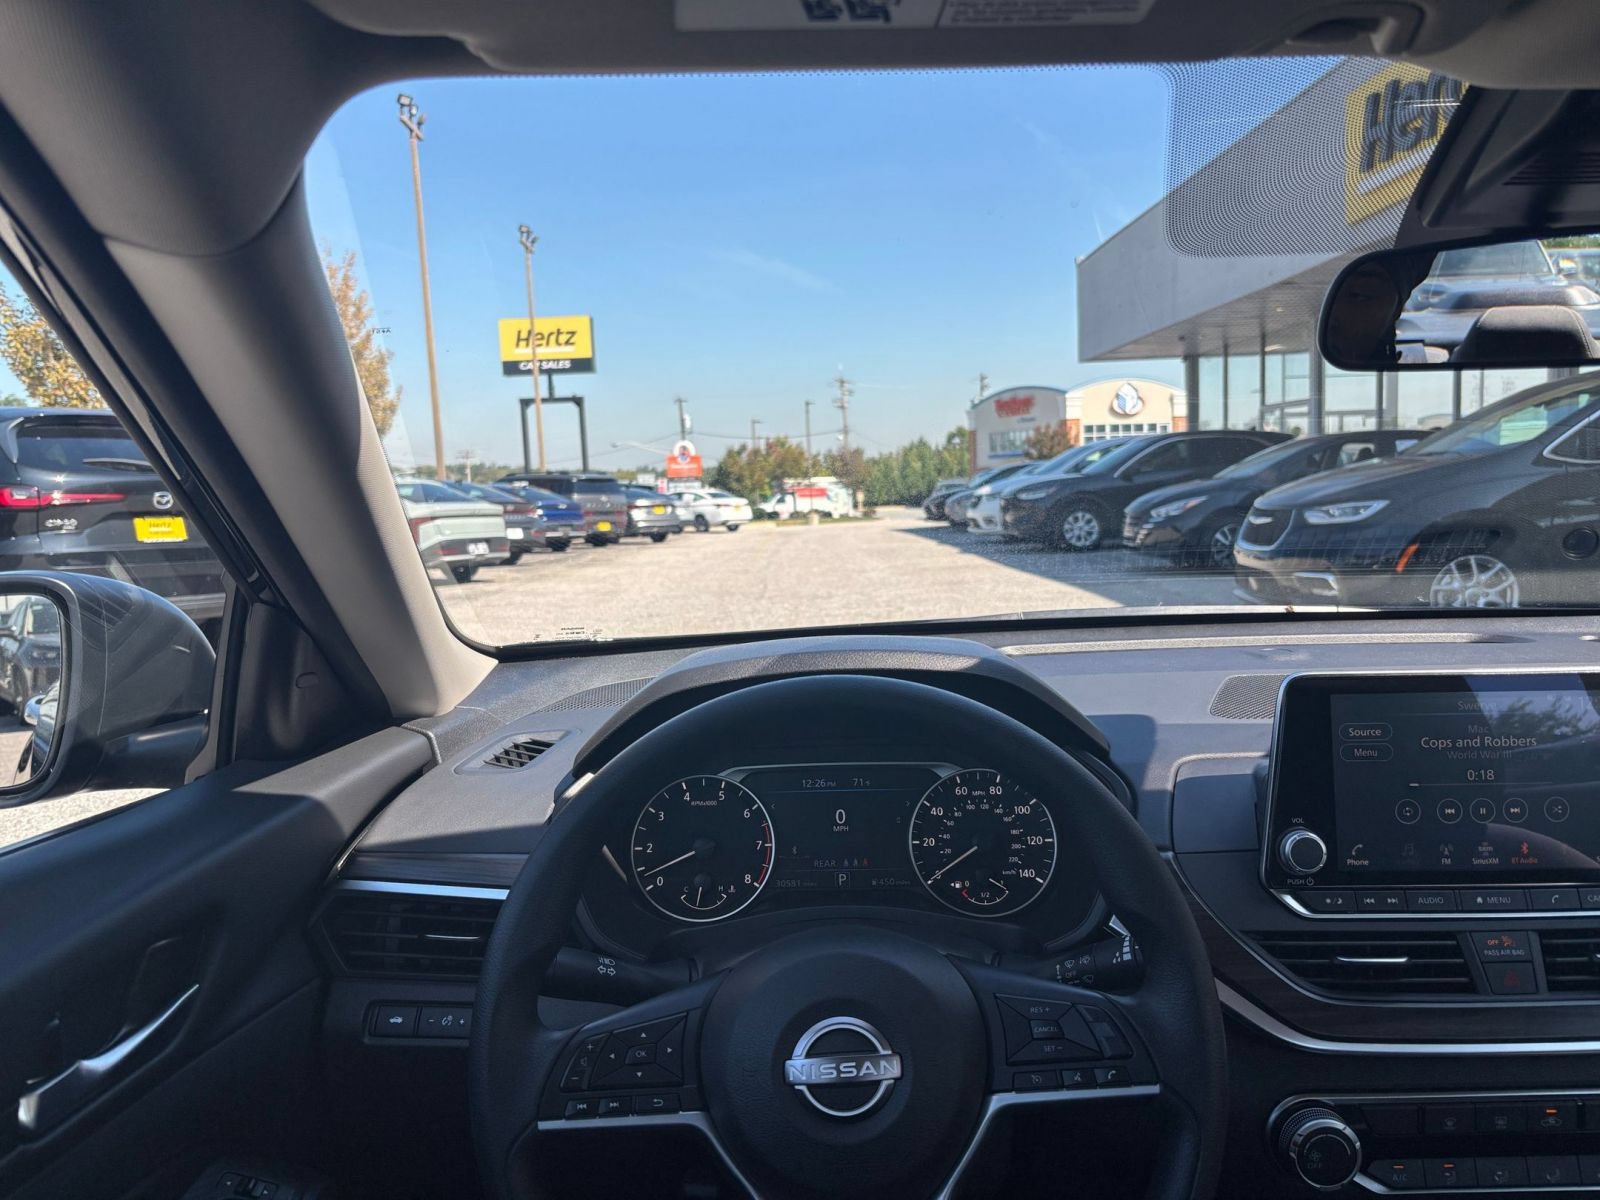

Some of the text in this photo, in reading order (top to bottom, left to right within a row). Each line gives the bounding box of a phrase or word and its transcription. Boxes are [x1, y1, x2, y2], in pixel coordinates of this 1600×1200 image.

[516, 328, 577, 348] Hertz
[541, 359, 571, 370] SALES
[1348, 727, 1382, 737] Source
[1468, 724, 1489, 734] Mac
[1421, 736, 1537, 750] Cops and Robbers
[1354, 748, 1378, 757] Menu
[1447, 750, 1476, 760] World
[1479, 750, 1500, 760] War
[1467, 769, 1495, 781] 0:18
[802, 779, 826, 788] 12:26
[955, 786, 968, 795] 60
[989, 786, 1002, 795] 80
[683, 792, 690, 801] 4
[719, 791, 725, 800] 5
[743, 809, 750, 818] 6
[930, 807, 943, 816] 40
[1014, 805, 1030, 815] 100
[658, 811, 665, 821] 3
[835, 809, 846, 824] 0
[923, 838, 935, 847] 20
[1026, 836, 1043, 845] 120
[646, 843, 653, 853] 2
[756, 841, 763, 850] 7
[814, 860, 836, 868] REAR
[1346, 858, 1370, 866] Phone
[1472, 857, 1499, 865] SiriusXM
[1520, 856, 1538, 864] Audio
[1019, 869, 1035, 878] 140
[657, 876, 664, 886] 0
[744, 874, 752, 884] 8
[839, 873, 847, 886] P
[1417, 896, 1444, 904] AUDIO
[1486, 896, 1511, 904] MENU
[1034, 1025, 1058, 1033] CANCEL
[789, 1059, 897, 1081] NISSAN
